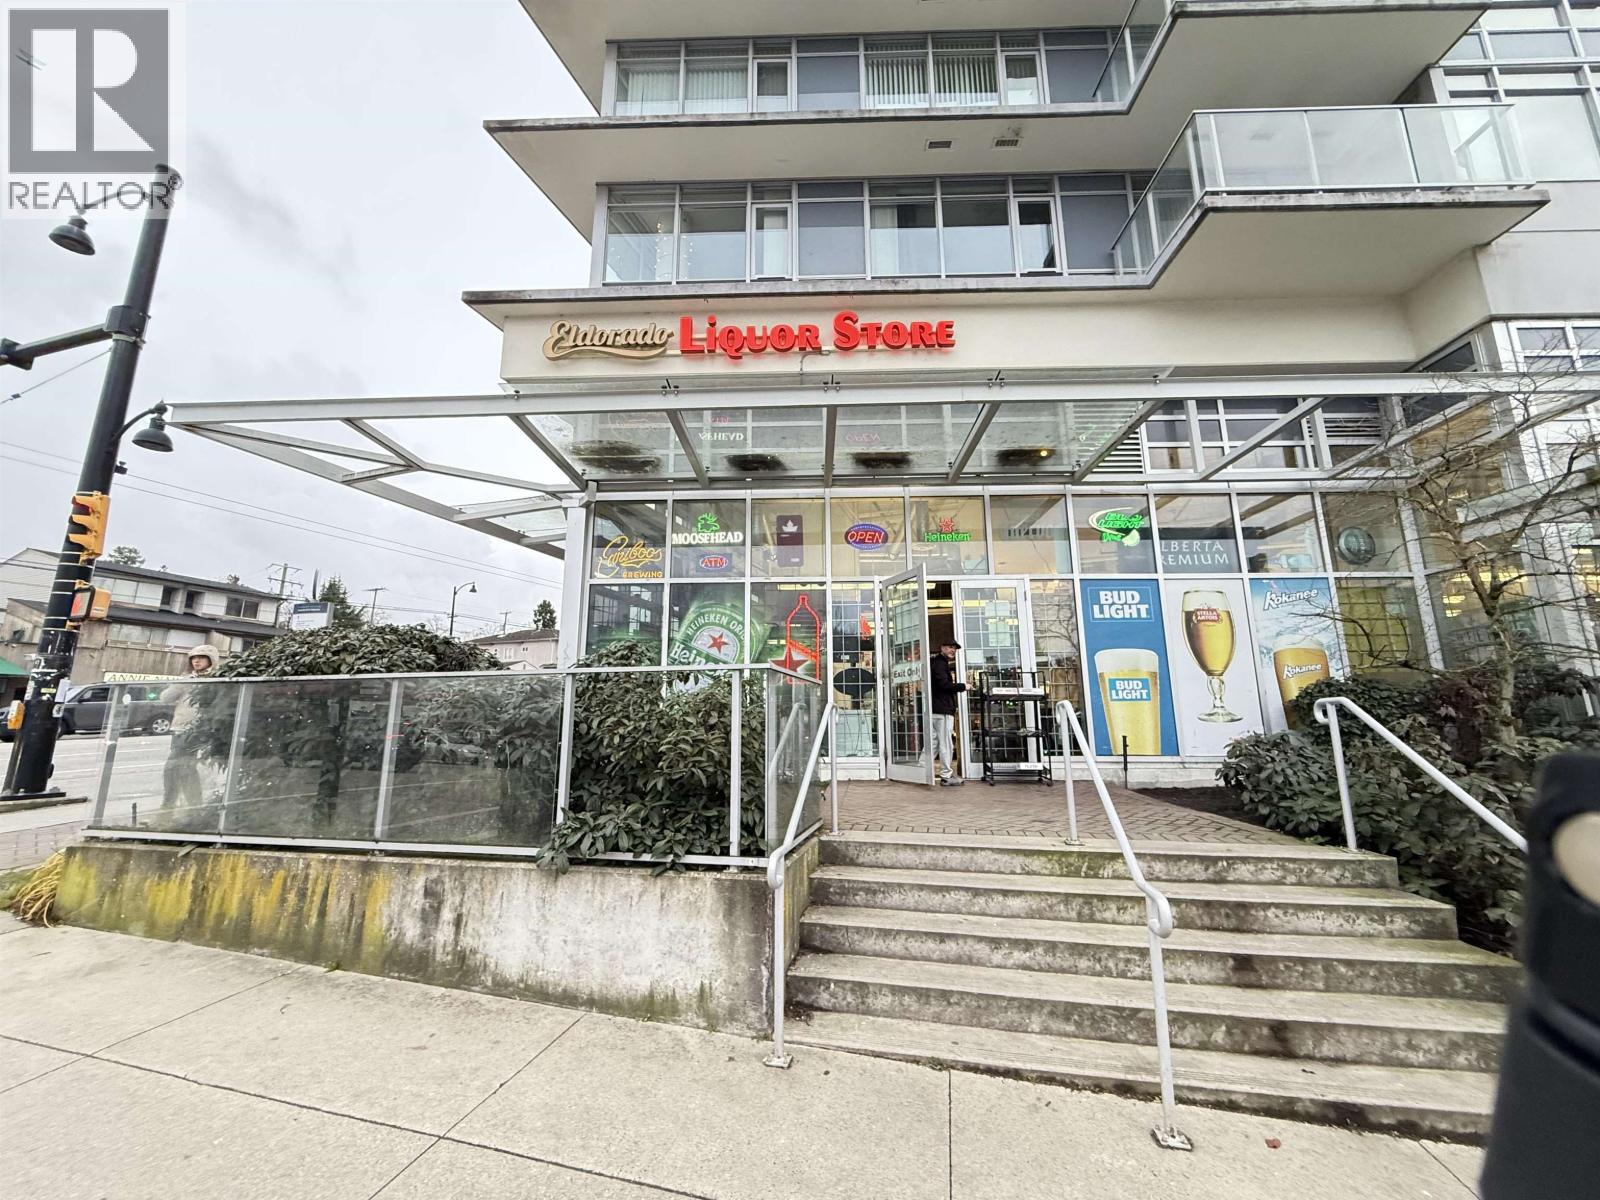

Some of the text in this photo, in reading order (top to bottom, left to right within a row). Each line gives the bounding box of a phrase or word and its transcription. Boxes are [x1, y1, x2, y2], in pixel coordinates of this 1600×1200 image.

[543, 320, 674, 360] Eldorado
[834, 311, 955, 350] STORE
[671, 531, 744, 545] MOOSEHEAD
[847, 531, 885, 543] OPEN
[924, 532, 971, 542] Heineken
[1160, 541, 1225, 552] LBERTA
[702, 557, 726, 567] ATM
[1100, 590, 1141, 605] BUD
[1263, 588, 1319, 610] Kokanee
[1093, 604, 1149, 619] LIGHT
[686, 613, 729, 636] HEINEKEN
[893, 670, 906, 678] Exit
[1282, 663, 1322, 680] Kokanee
[1115, 680, 1143, 690] BUD
[1111, 689, 1149, 700] LIGHT
